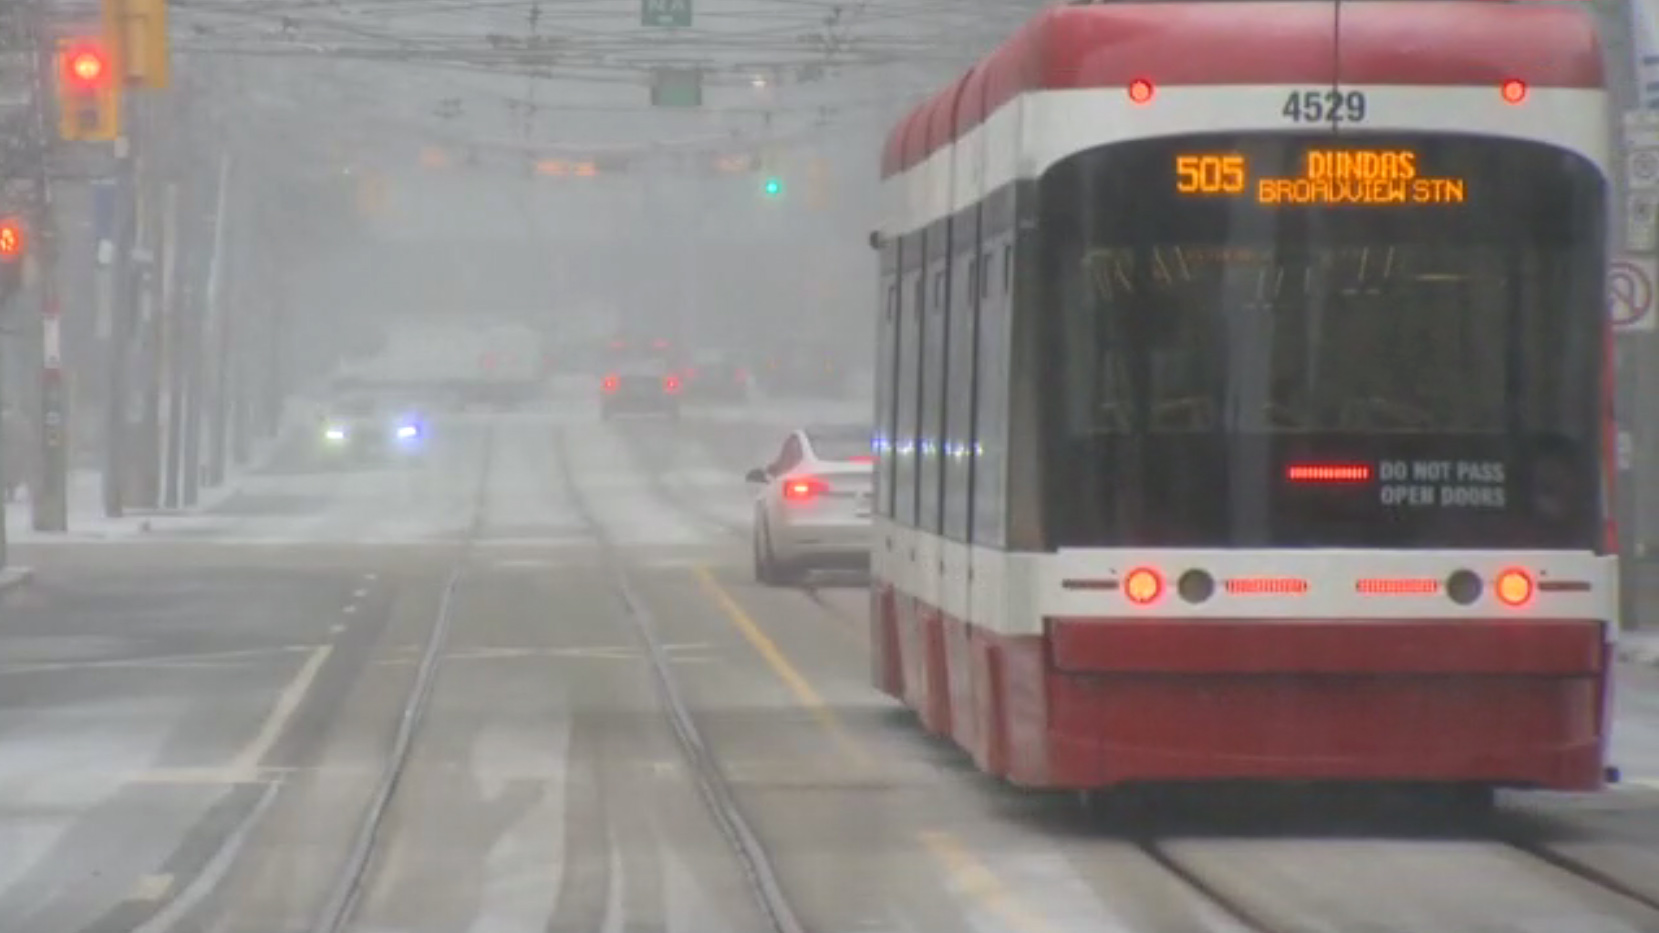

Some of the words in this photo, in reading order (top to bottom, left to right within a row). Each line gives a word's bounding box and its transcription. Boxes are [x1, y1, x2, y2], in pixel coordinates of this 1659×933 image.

[1282, 91, 1366, 123] 4529
[1176, 156, 1244, 193] 505
[1308, 150, 1416, 179] DUNDAS
[1258, 179, 1407, 203] BROADVIEW
[1413, 179, 1464, 203] STN
[1380, 462, 1408, 481] DO
[1413, 462, 1450, 481] NOT
[1456, 462, 1505, 482] PASS
[1380, 486, 1435, 506] OPEN
[1441, 486, 1505, 507] DOORS
